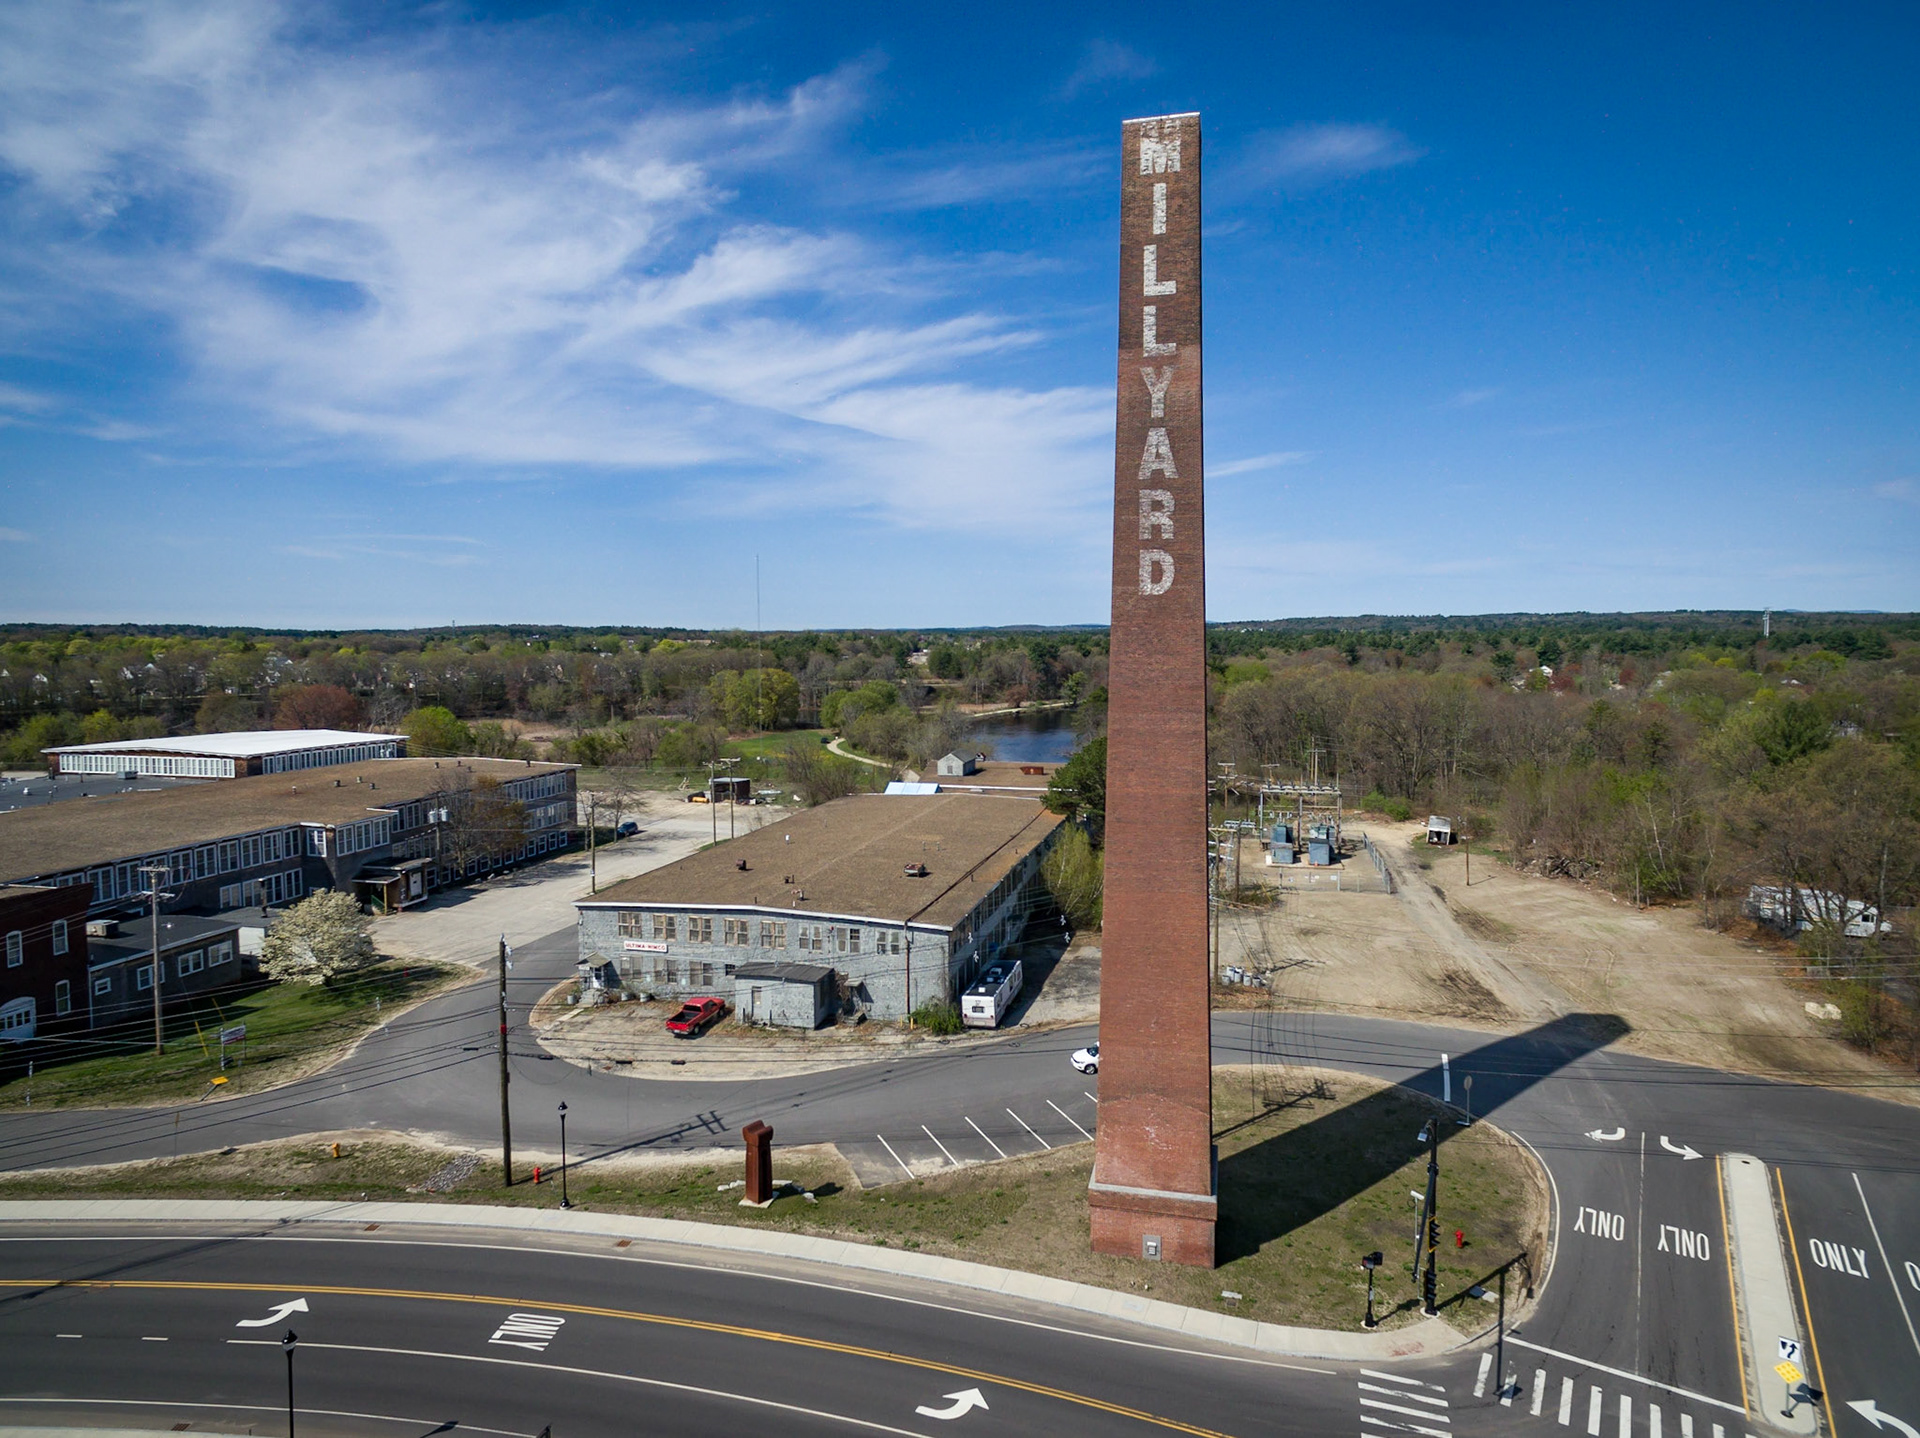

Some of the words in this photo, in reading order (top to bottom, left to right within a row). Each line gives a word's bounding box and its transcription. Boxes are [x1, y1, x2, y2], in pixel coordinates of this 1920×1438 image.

[1138, 121, 1181, 596] MILLYARD
[1574, 1206, 1625, 1241] ONLY
[1657, 1224, 1710, 1261] ONLY
[1809, 1238, 1870, 1279] ONLY
[488, 1313, 566, 1351] ONLY
